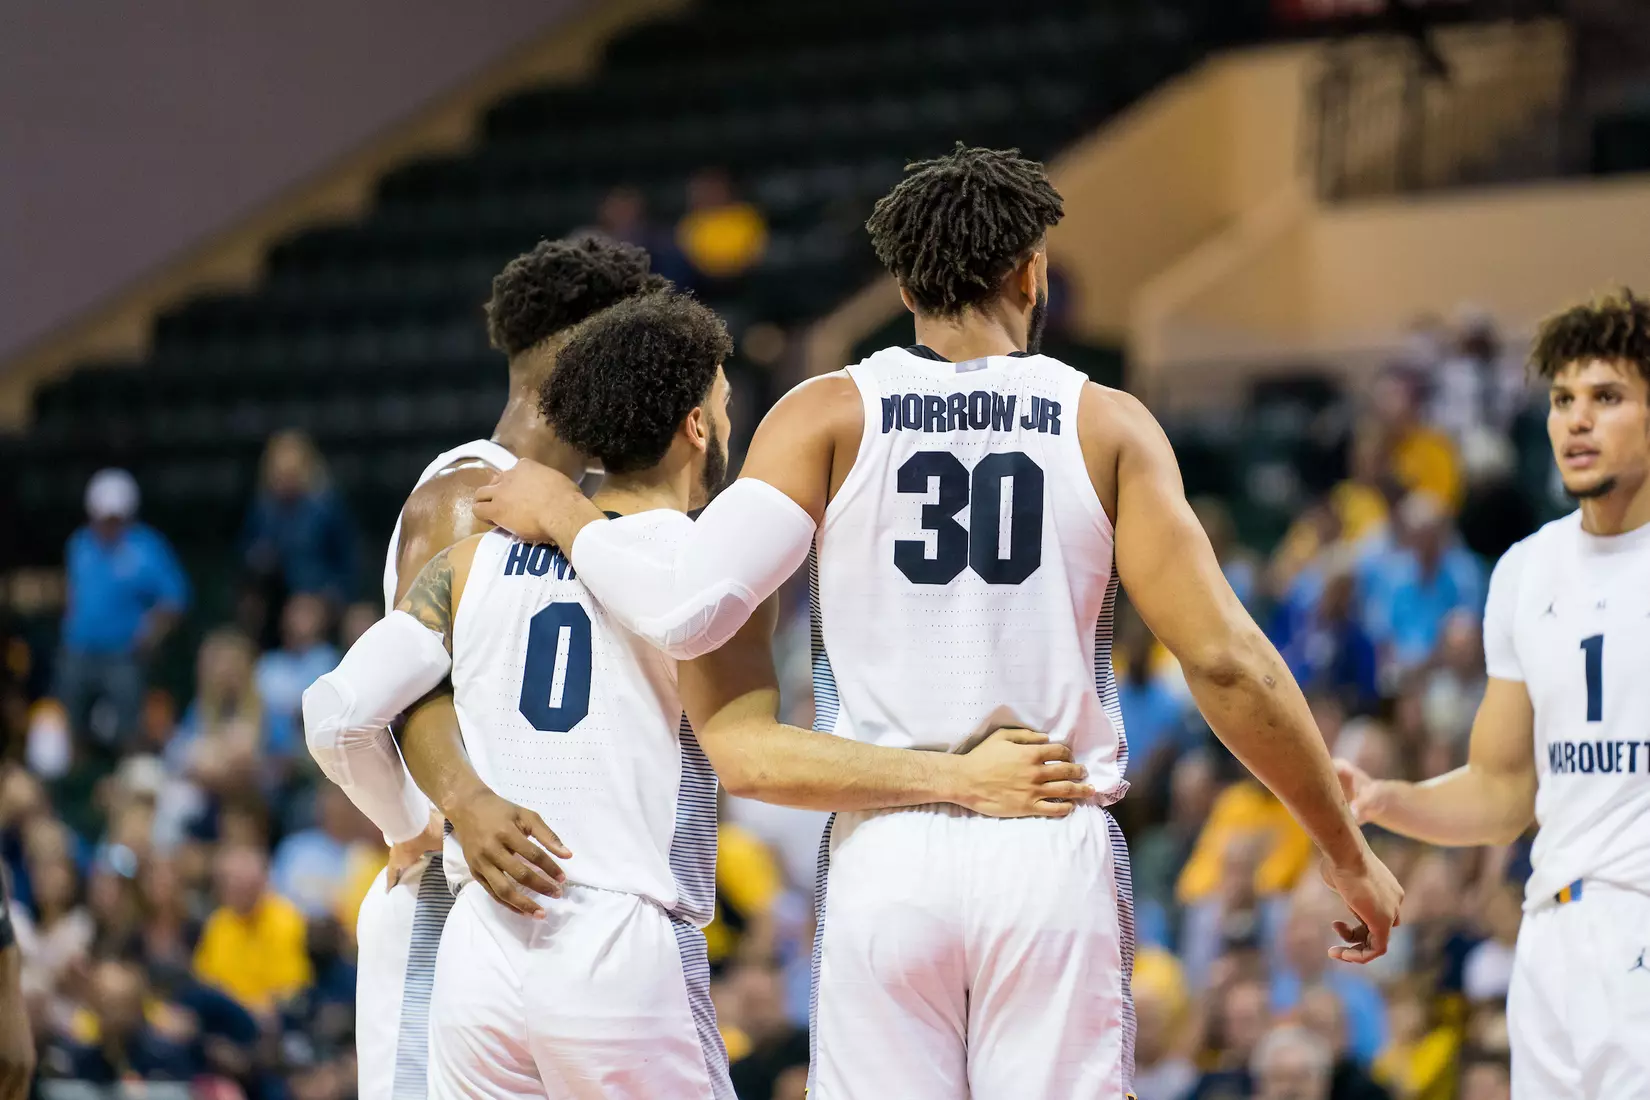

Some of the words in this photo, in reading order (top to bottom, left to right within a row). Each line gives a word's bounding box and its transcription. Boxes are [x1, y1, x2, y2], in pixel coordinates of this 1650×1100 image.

[881, 390, 1017, 433] MORROW
[1021, 396, 1062, 436] JR
[894, 451, 1044, 585] 30
[518, 602, 592, 733] 0
[1580, 634, 1604, 721] 1
